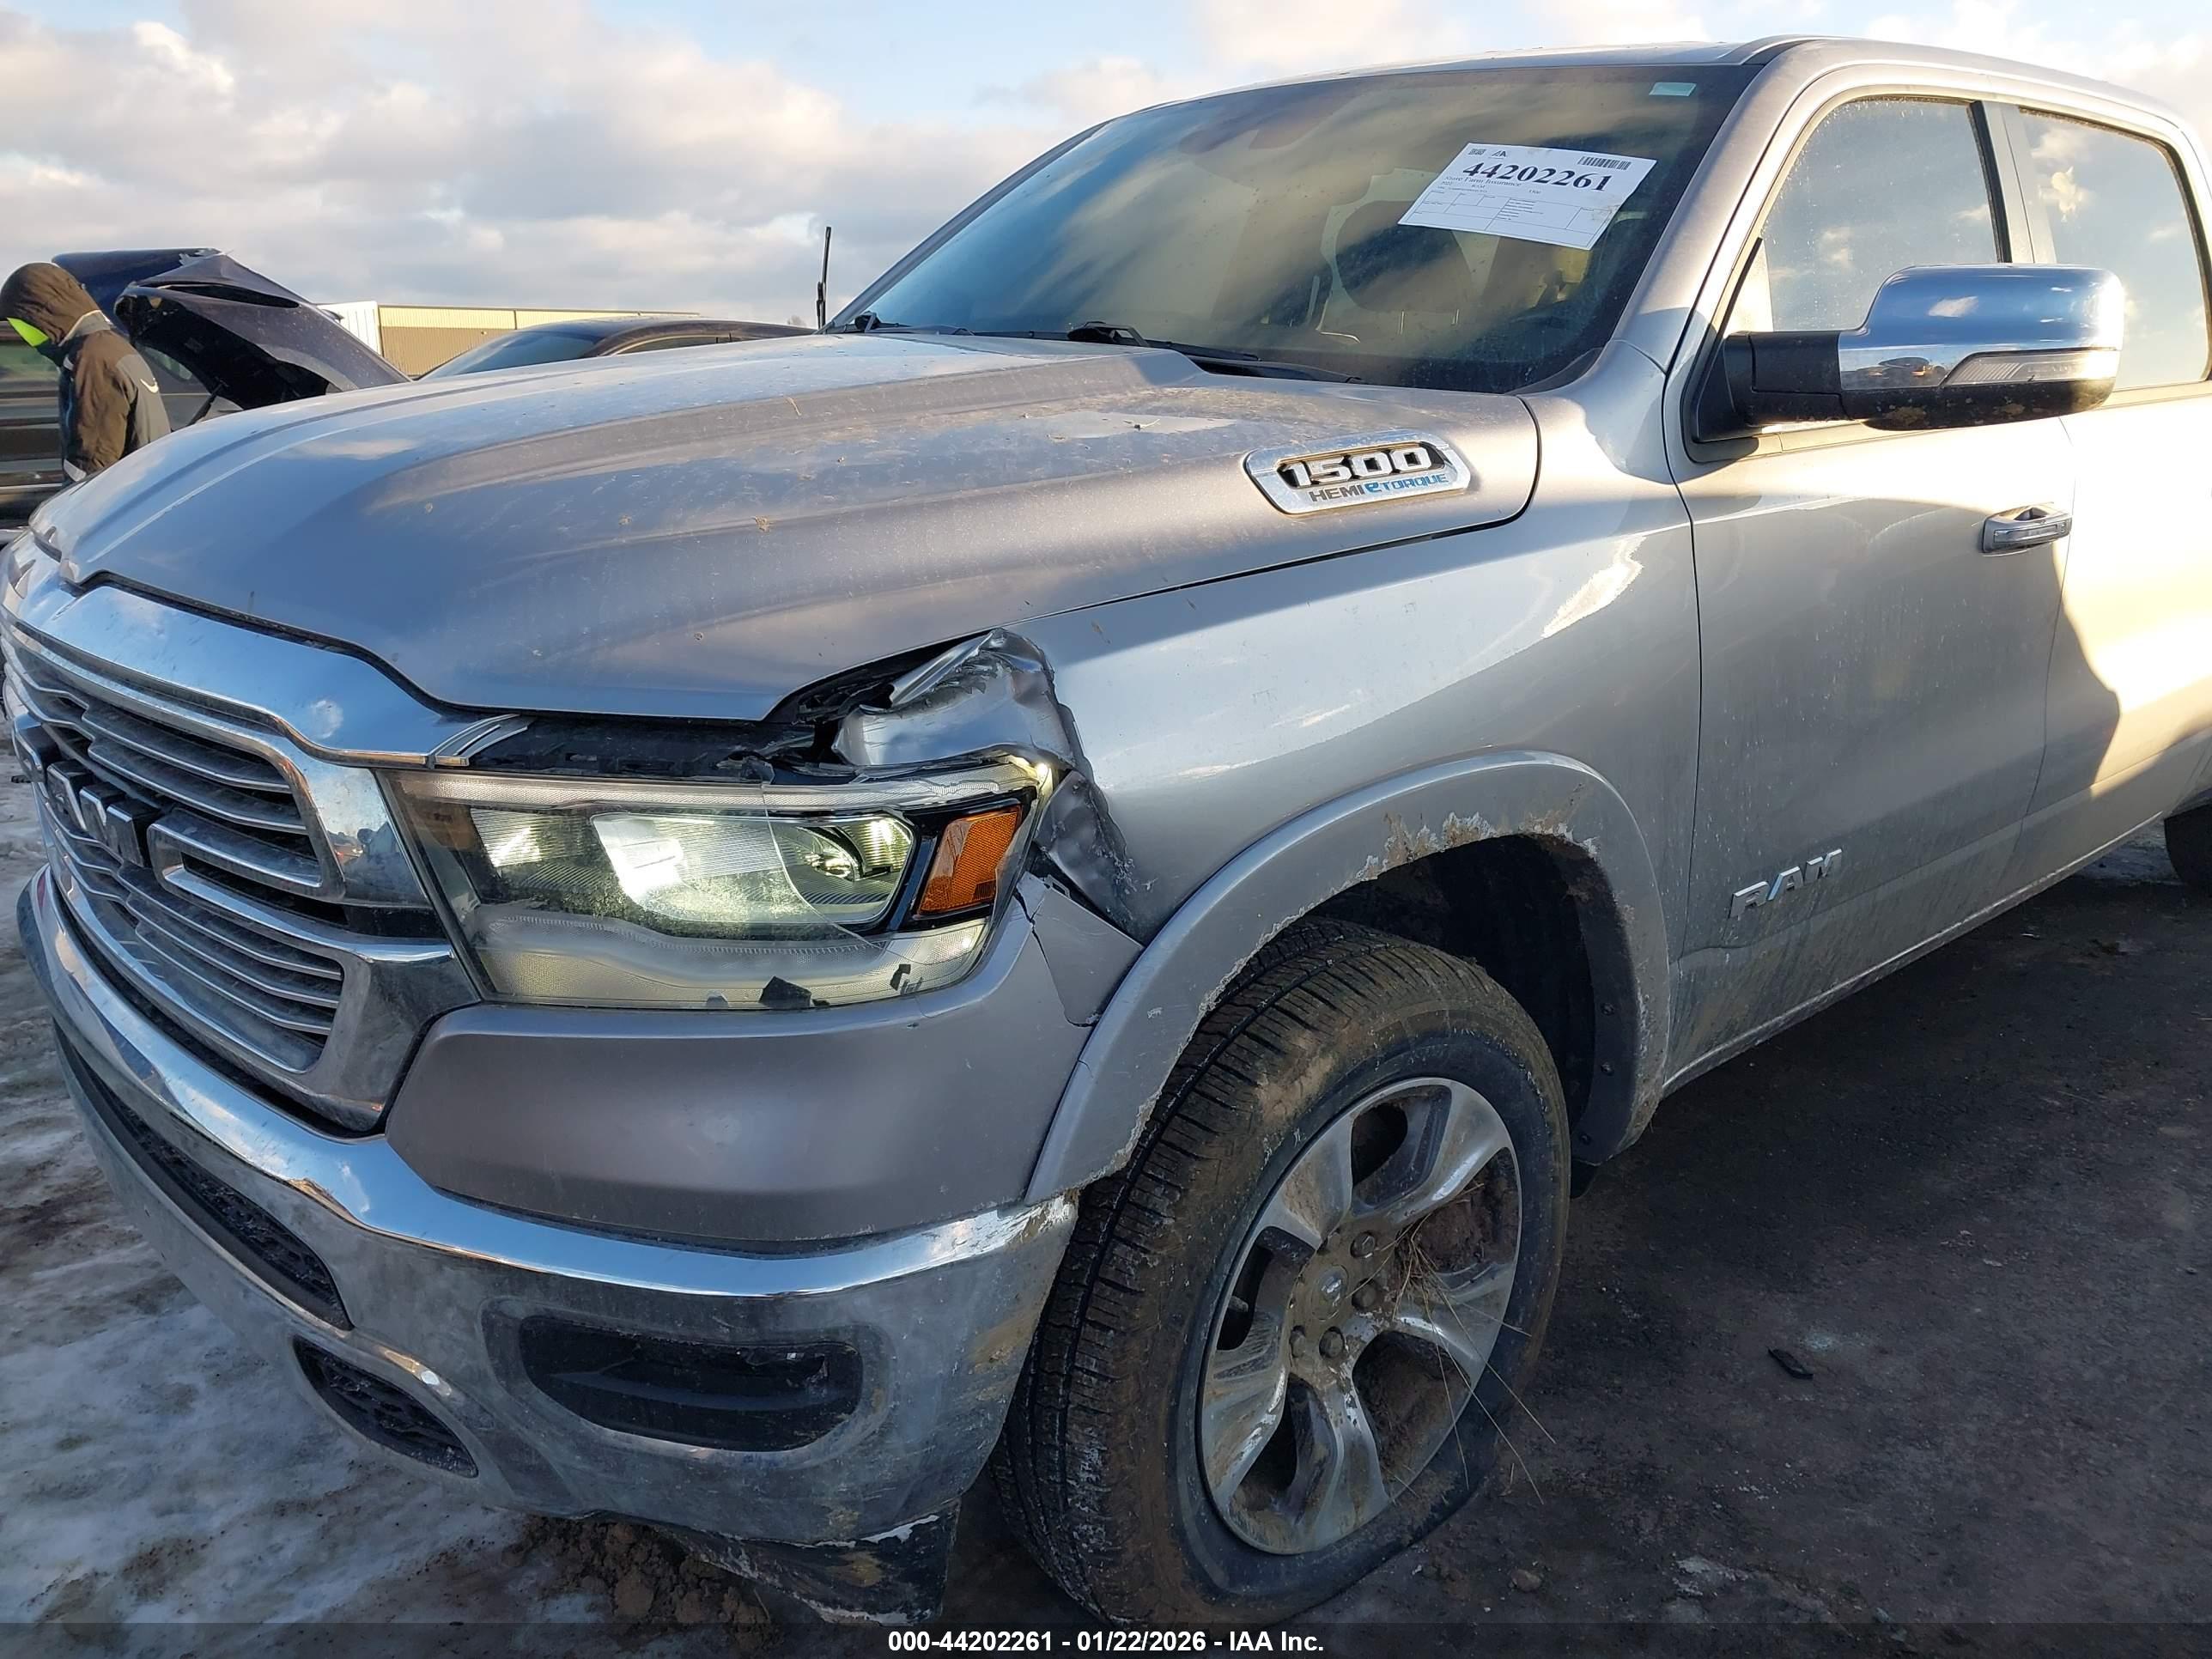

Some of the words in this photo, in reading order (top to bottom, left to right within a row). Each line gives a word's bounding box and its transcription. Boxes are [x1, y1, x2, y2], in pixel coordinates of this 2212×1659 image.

[1462, 161, 1613, 191] 44202261
[1283, 447, 1432, 488] 1500
[1309, 484, 1365, 501] HEMI
[1728, 848, 1843, 919] RAM
